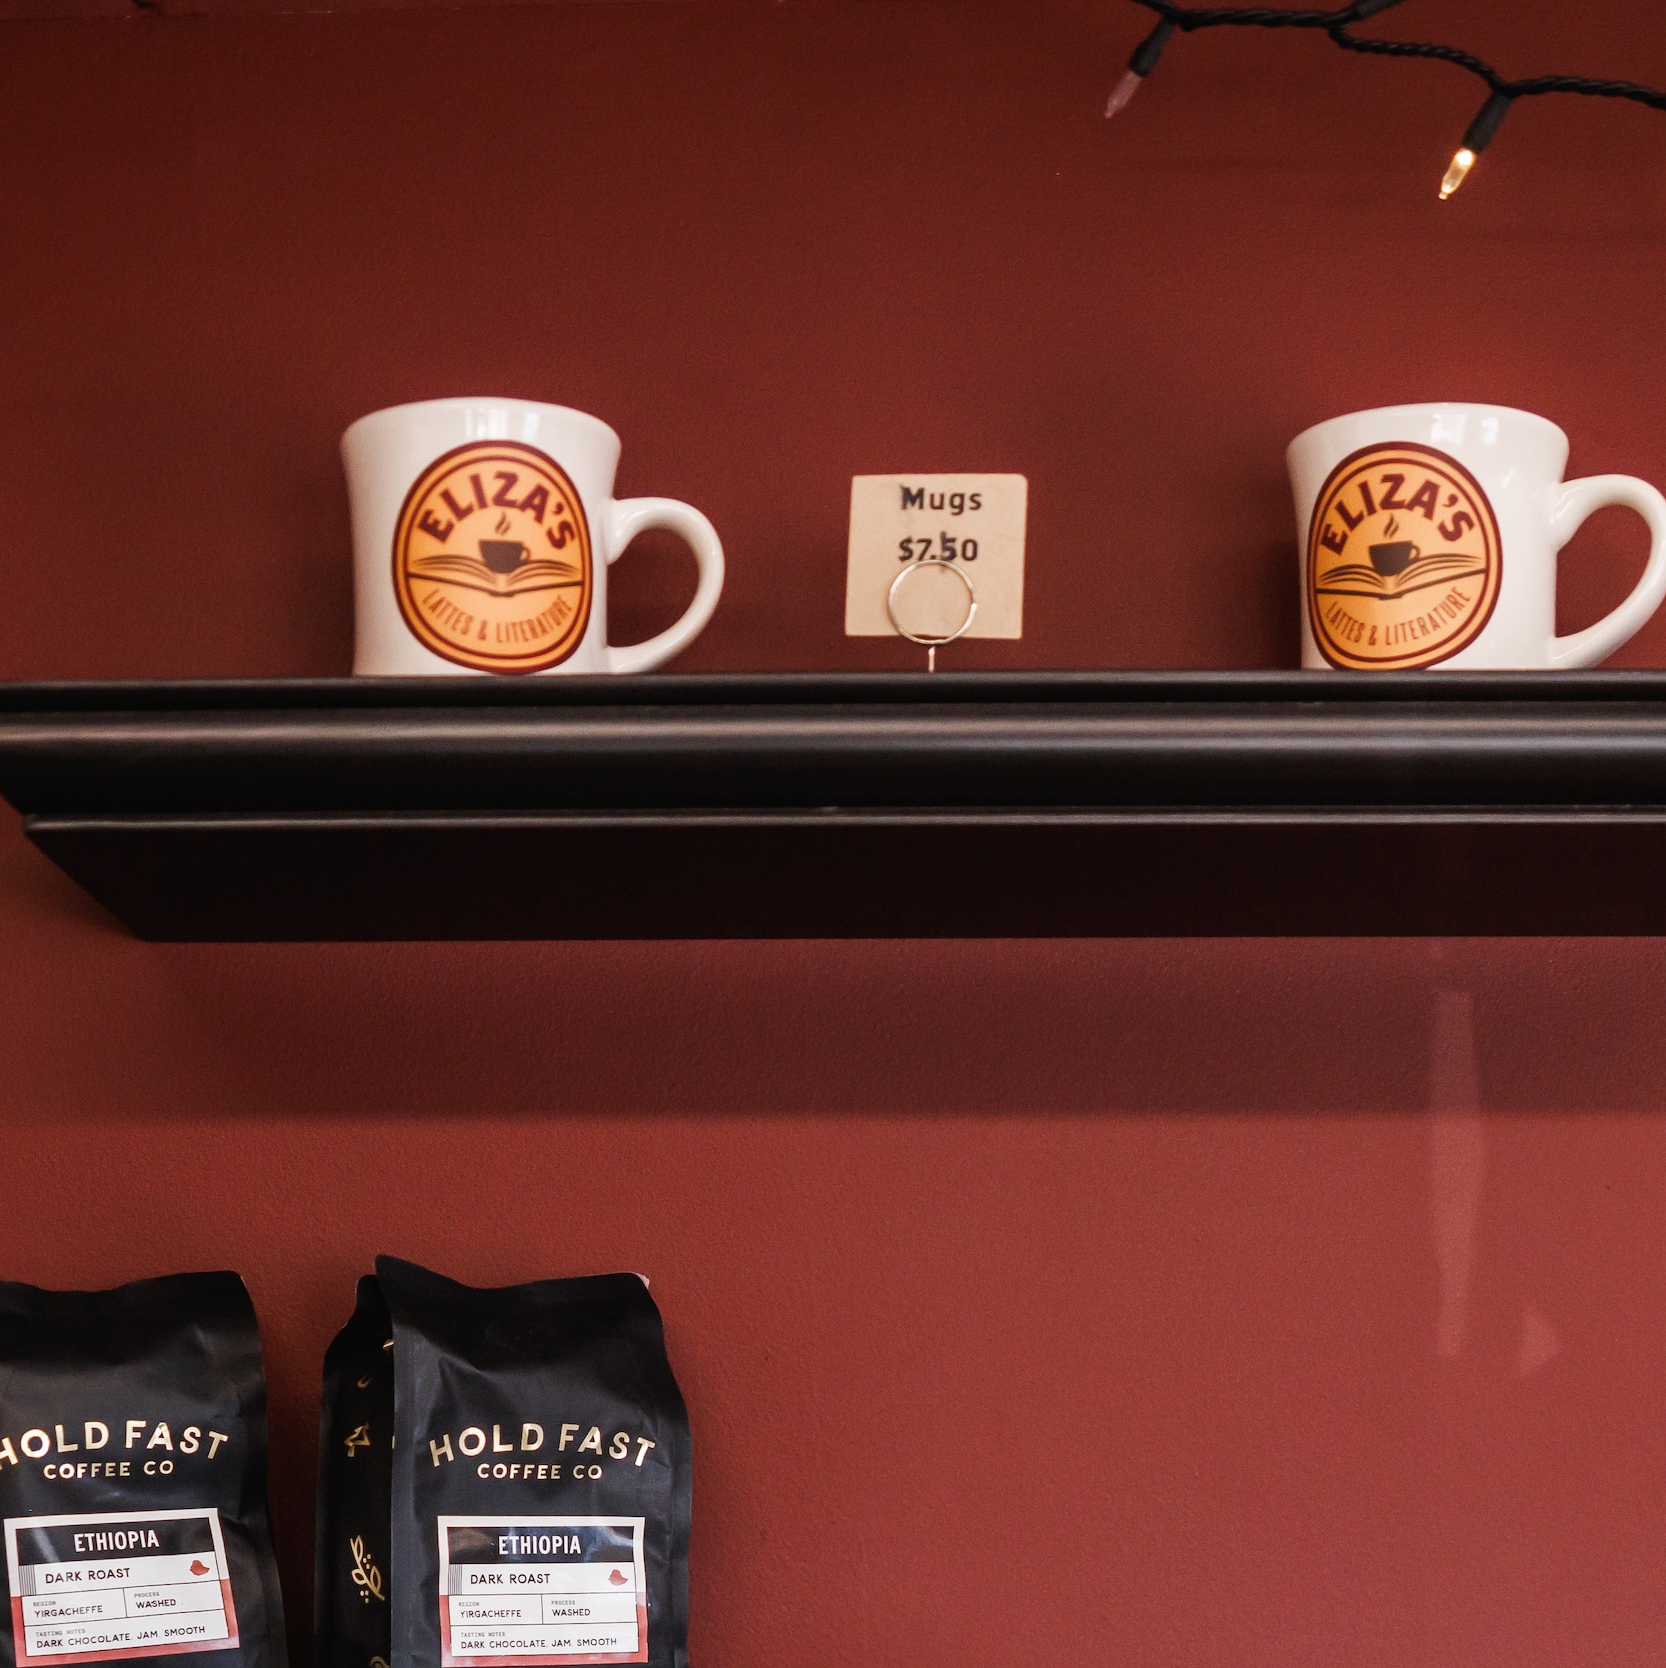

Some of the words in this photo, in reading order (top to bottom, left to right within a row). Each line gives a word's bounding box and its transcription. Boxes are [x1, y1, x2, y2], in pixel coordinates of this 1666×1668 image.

[418, 471, 575, 549] ELIZA'S
[900, 485, 982, 515] Mugs
[1320, 473, 1475, 555] ELIZA'S
[898, 535, 978, 563] $7.50
[422, 588, 473, 635] LATTES
[477, 620, 488, 641] &
[496, 594, 572, 643] LITERATURE
[1325, 602, 1365, 644] LATTES
[1368, 625, 1378, 646] &
[1386, 586, 1471, 646] LITERATURE
[125, 1419, 229, 1460] FAST
[429, 1422, 544, 1467] HOLD
[559, 1424, 656, 1467] FAST
[43, 1461, 131, 1479] COFFEE
[143, 1460, 174, 1476] CO
[477, 1463, 561, 1479] COFFEE
[573, 1464, 603, 1479] CO
[73, 1529, 160, 1553] ETHIOPIA
[498, 1535, 582, 1555] ETHIOPIA
[45, 1571, 83, 1584] DARK
[88, 1567, 131, 1581] ROAST
[470, 1573, 504, 1585] DARK
[509, 1573, 551, 1585] ROAST
[34, 1605, 103, 1618] YIRGACHEFFE
[136, 1598, 176, 1609] WASHED
[460, 1609, 522, 1618] YIRGACHEFFE
[552, 1608, 591, 1617] WASHED
[36, 1639, 63, 1648] DARK
[165, 1626, 206, 1636] SMOOTH
[461, 1641, 485, 1649] DARK
[577, 1638, 617, 1647] SMOOTH
